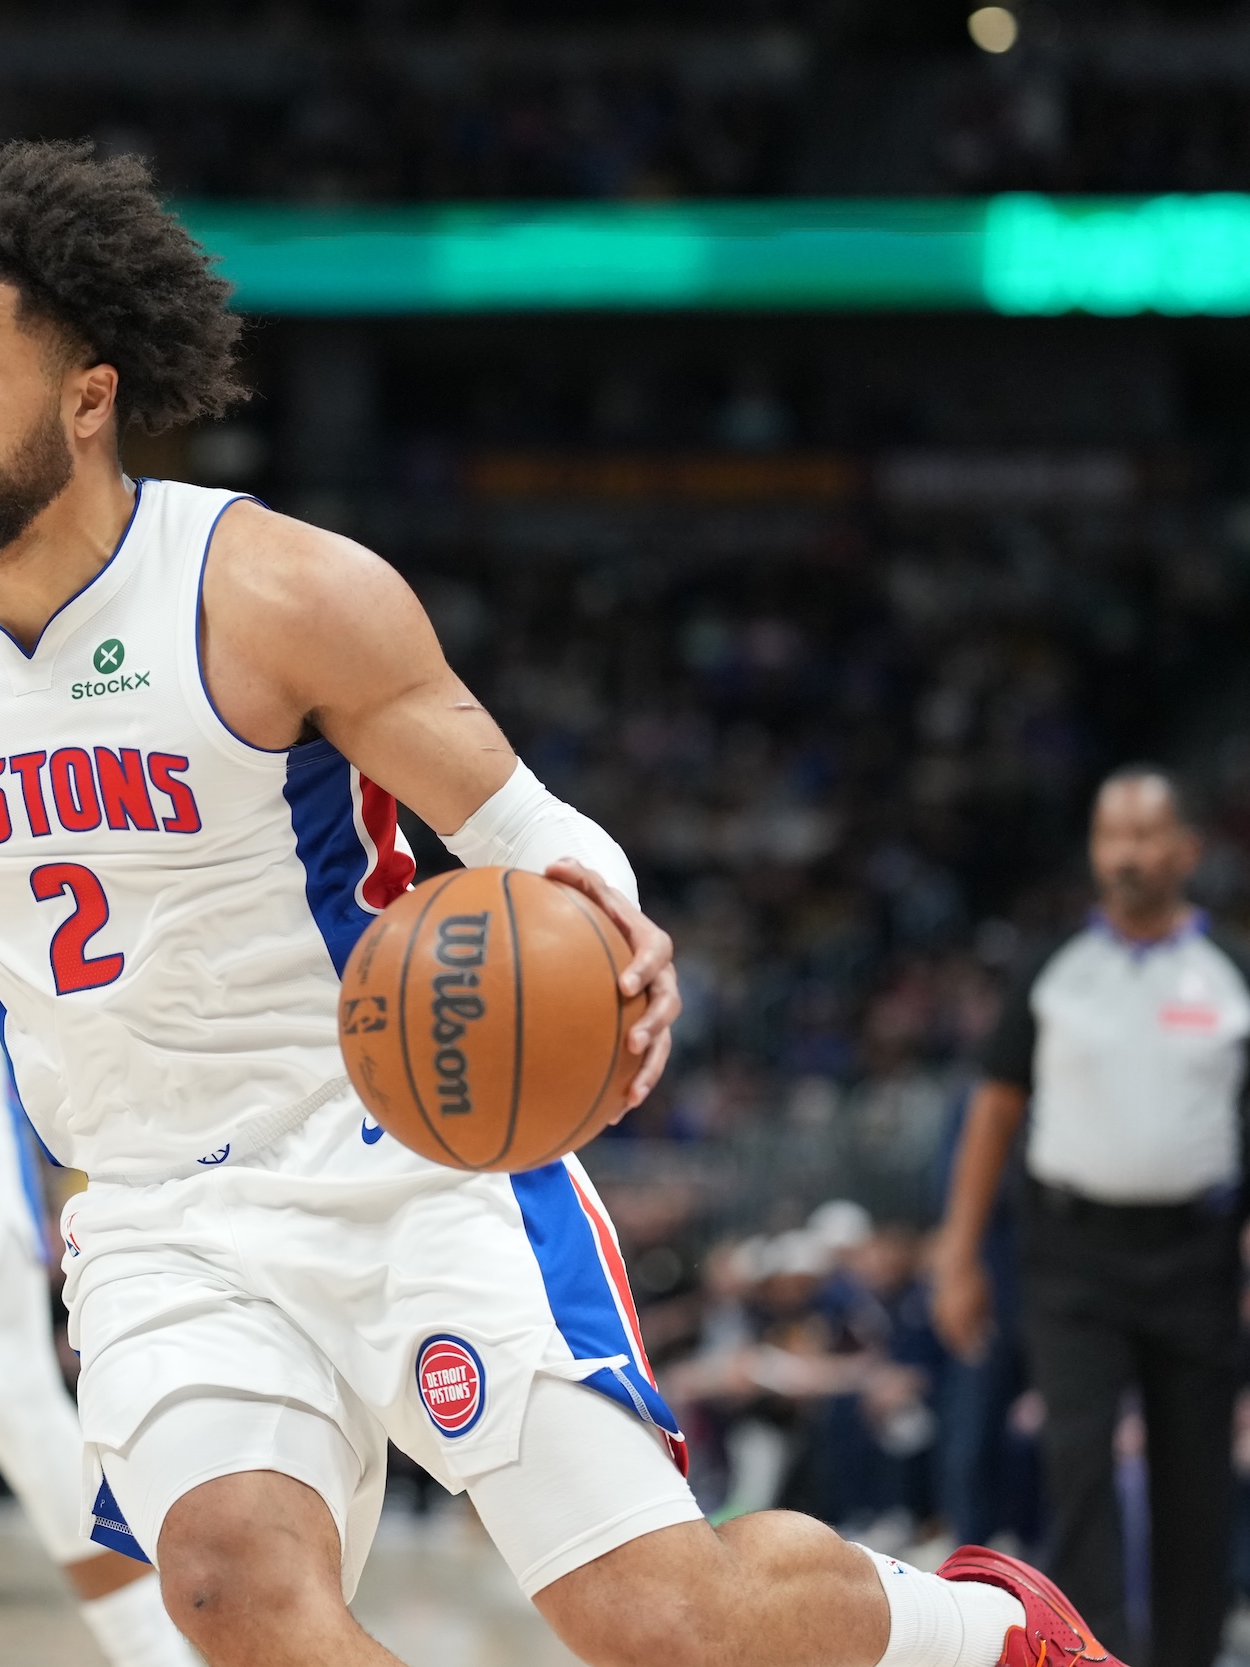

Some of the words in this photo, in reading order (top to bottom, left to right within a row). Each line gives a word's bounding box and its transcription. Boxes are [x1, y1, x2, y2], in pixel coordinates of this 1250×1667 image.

[71, 670, 150, 700] StockX
[29, 862, 125, 996] 2
[431, 910, 492, 1118] Wilson
[424, 1364, 467, 1388] DETROIT
[428, 1382, 471, 1405] PISTONS
